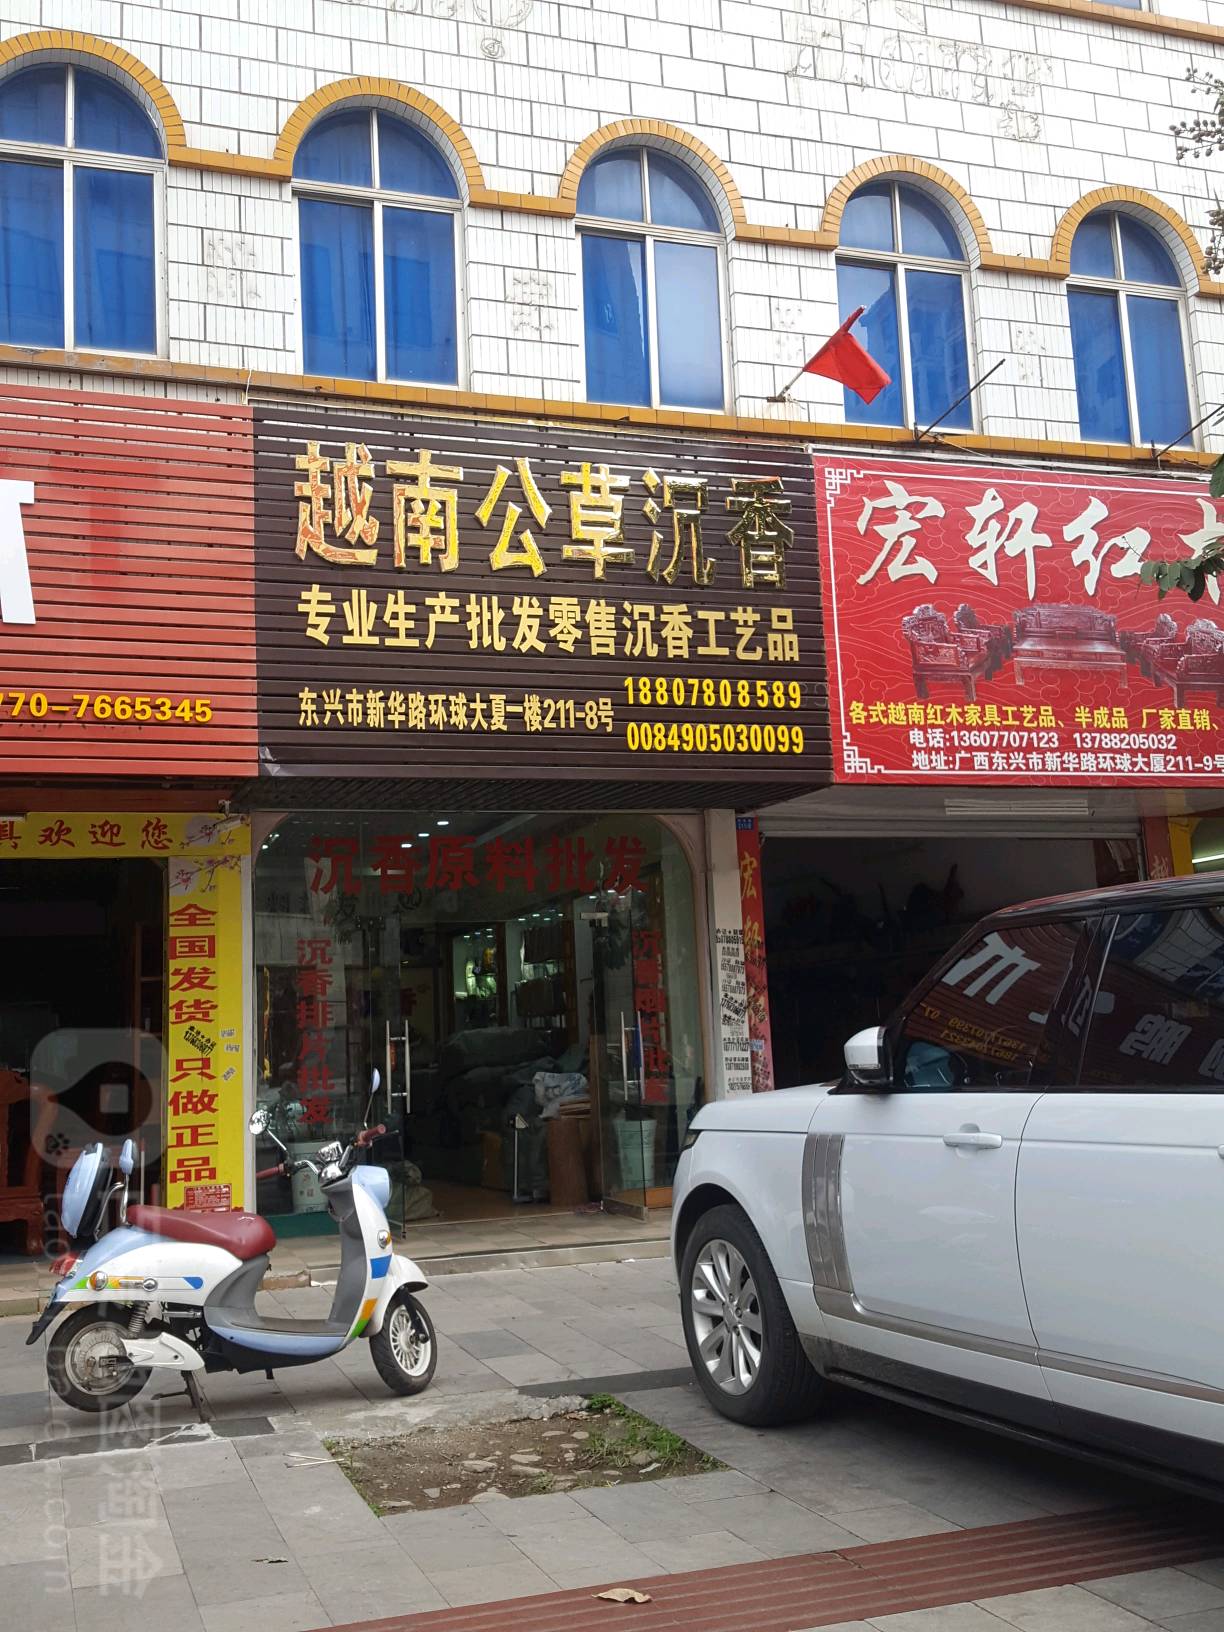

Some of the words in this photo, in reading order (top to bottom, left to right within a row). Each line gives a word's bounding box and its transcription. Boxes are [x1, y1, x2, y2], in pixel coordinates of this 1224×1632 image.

[294, 439, 796, 590] 越南公草沉香
[297, 583, 801, 662] 专业生产批发零售沉香工艺品
[0, 691, 213, 723] 70-7665345
[624, 676, 801, 709] 18807808589
[626, 722, 804, 754] 0084905030099
[1073, 733, 1178, 750] 13788205032
[308, 834, 649, 895] 沉香原料批发
